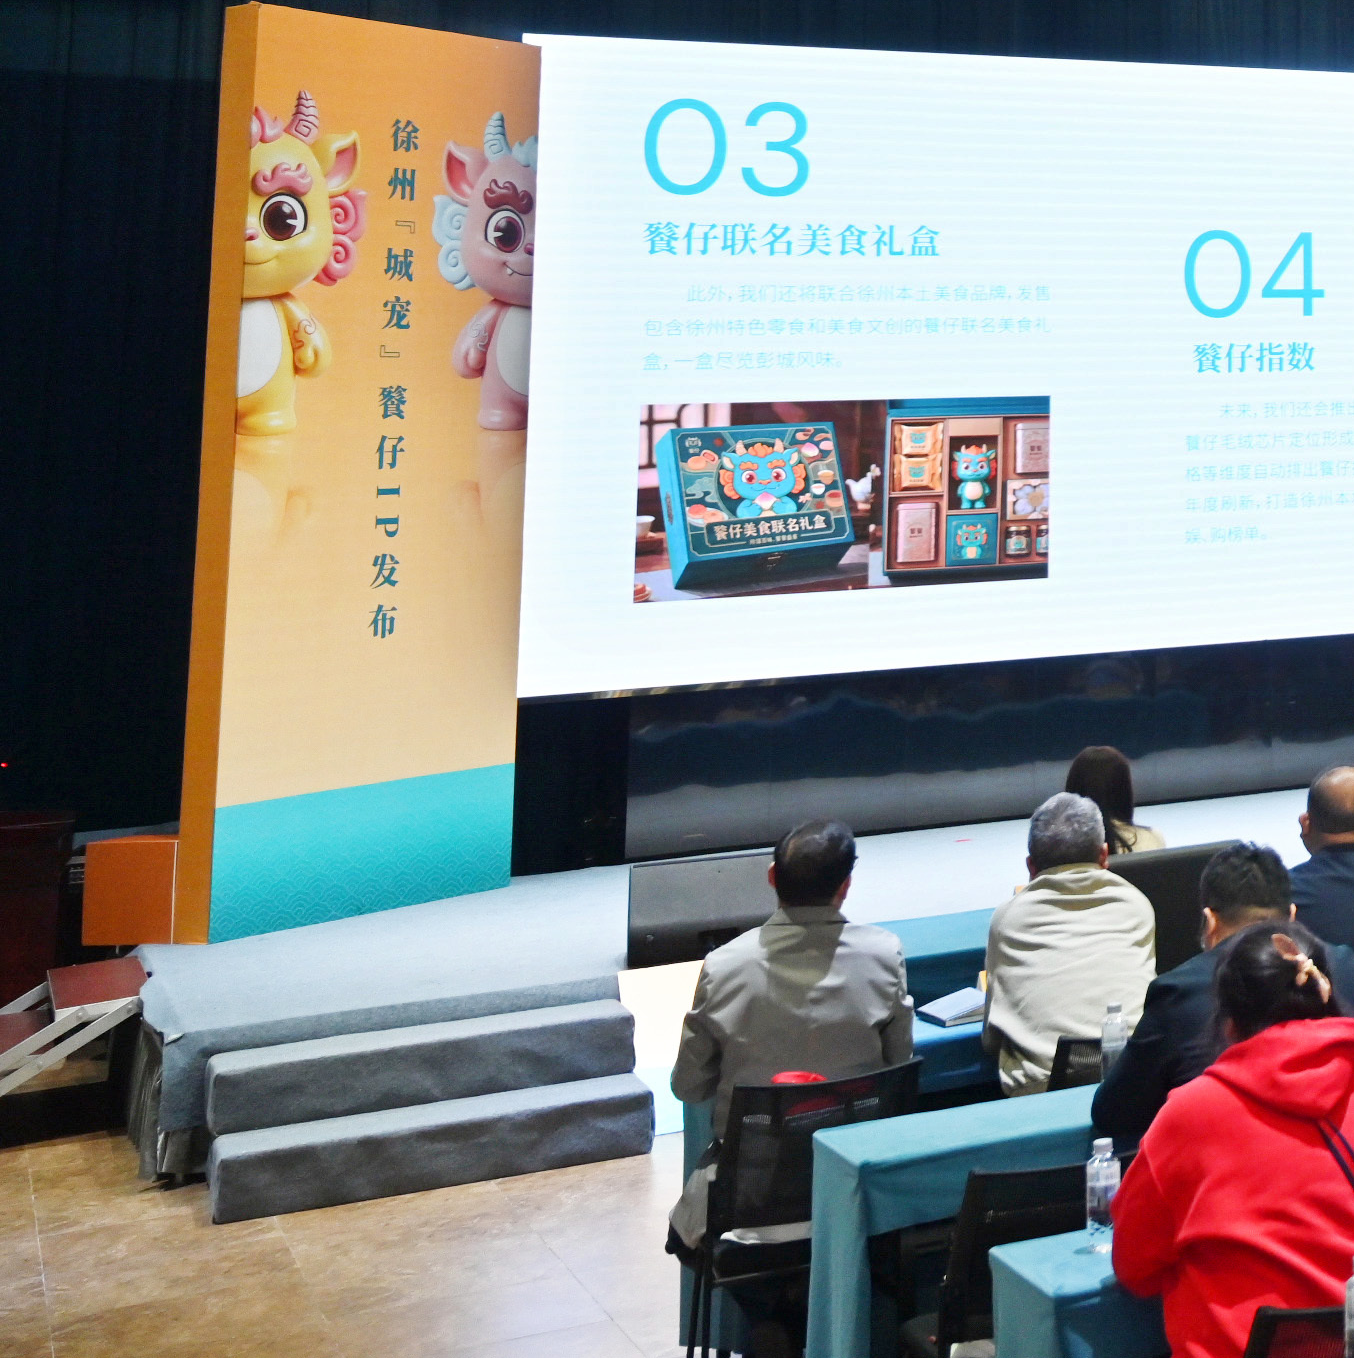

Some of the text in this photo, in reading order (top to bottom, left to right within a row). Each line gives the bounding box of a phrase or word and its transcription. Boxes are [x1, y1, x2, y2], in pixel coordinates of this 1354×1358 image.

[643, 98, 810, 197] 03
[643, 221, 941, 257] 餮仔联名美食礼盒
[1184, 229, 1325, 319] 04
[1193, 342, 1316, 374] 餮仔指数
